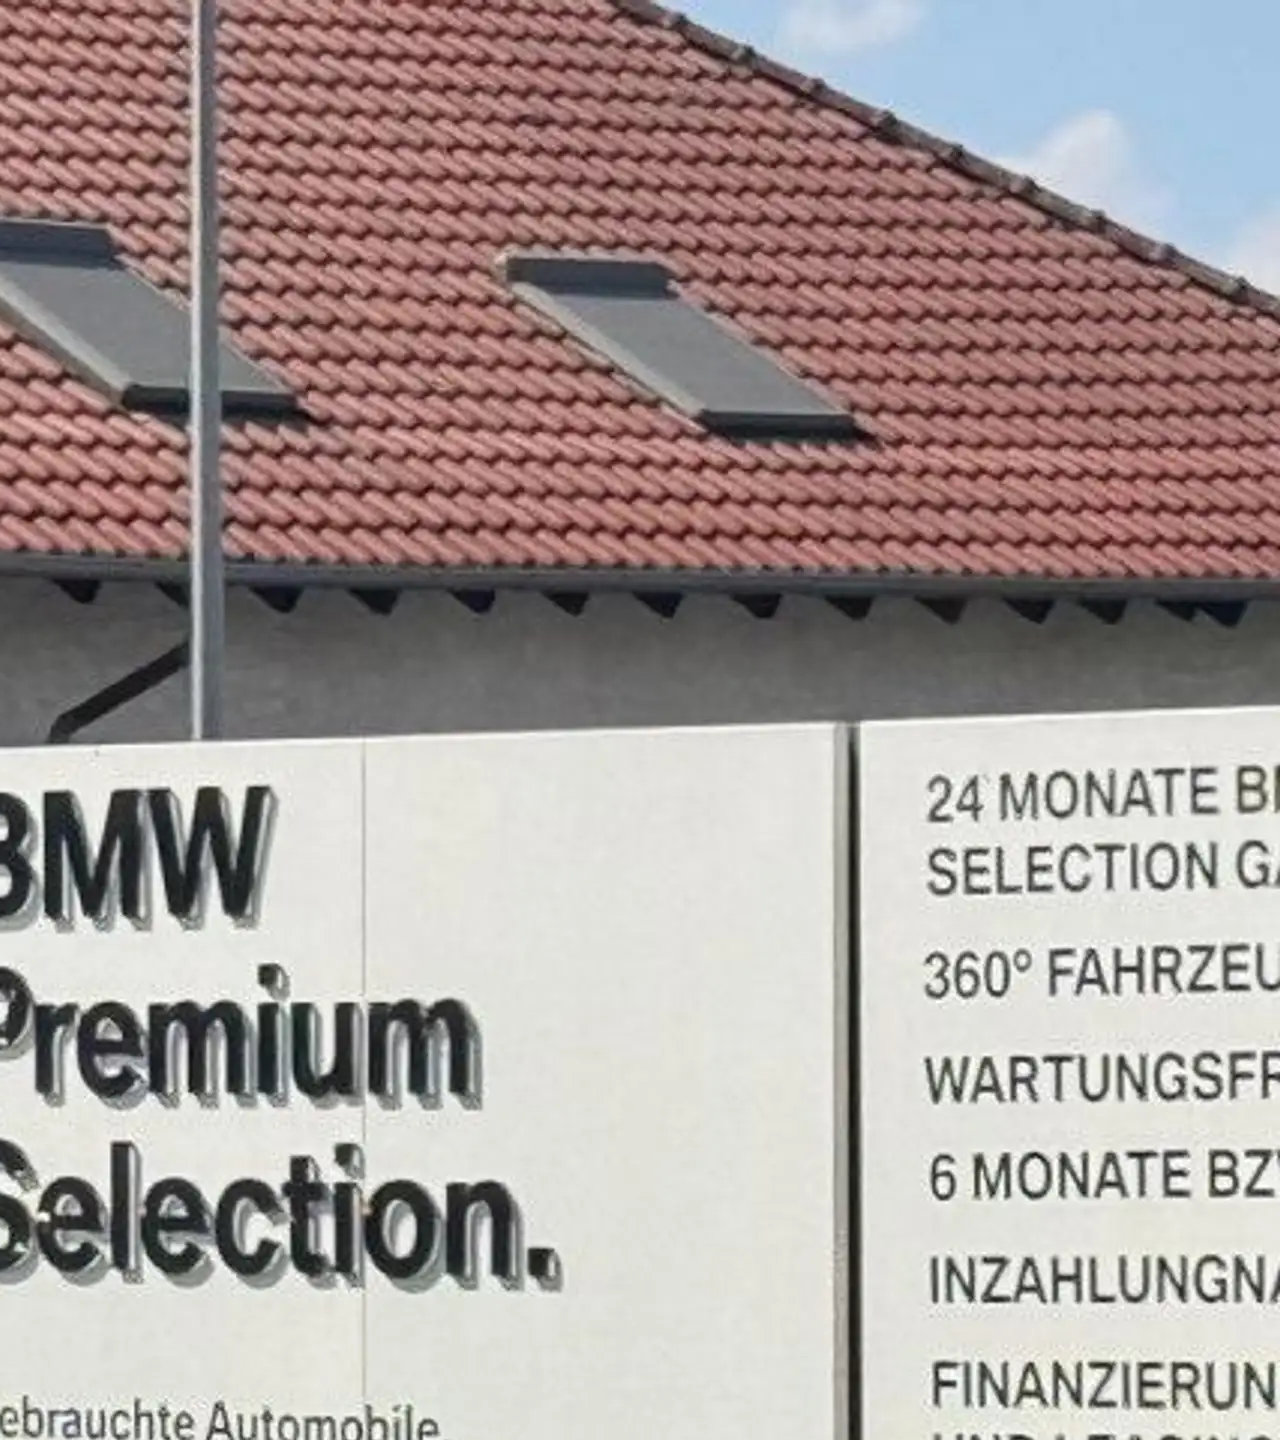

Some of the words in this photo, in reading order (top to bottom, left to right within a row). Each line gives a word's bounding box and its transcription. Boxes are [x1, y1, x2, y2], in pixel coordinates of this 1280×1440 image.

[926, 775, 984, 823] 24
[998, 767, 1219, 821] MONATE
[1236, 764, 1280, 814] B
[926, 841, 1218, 896] SELECTION
[1236, 839, 1280, 889] G
[930, 1153, 957, 1201] 6
[973, 1149, 1191, 1201] MONATE
[1208, 1149, 1280, 1198] BZ
[932, 1360, 1276, 1411] FINANZIERUN
